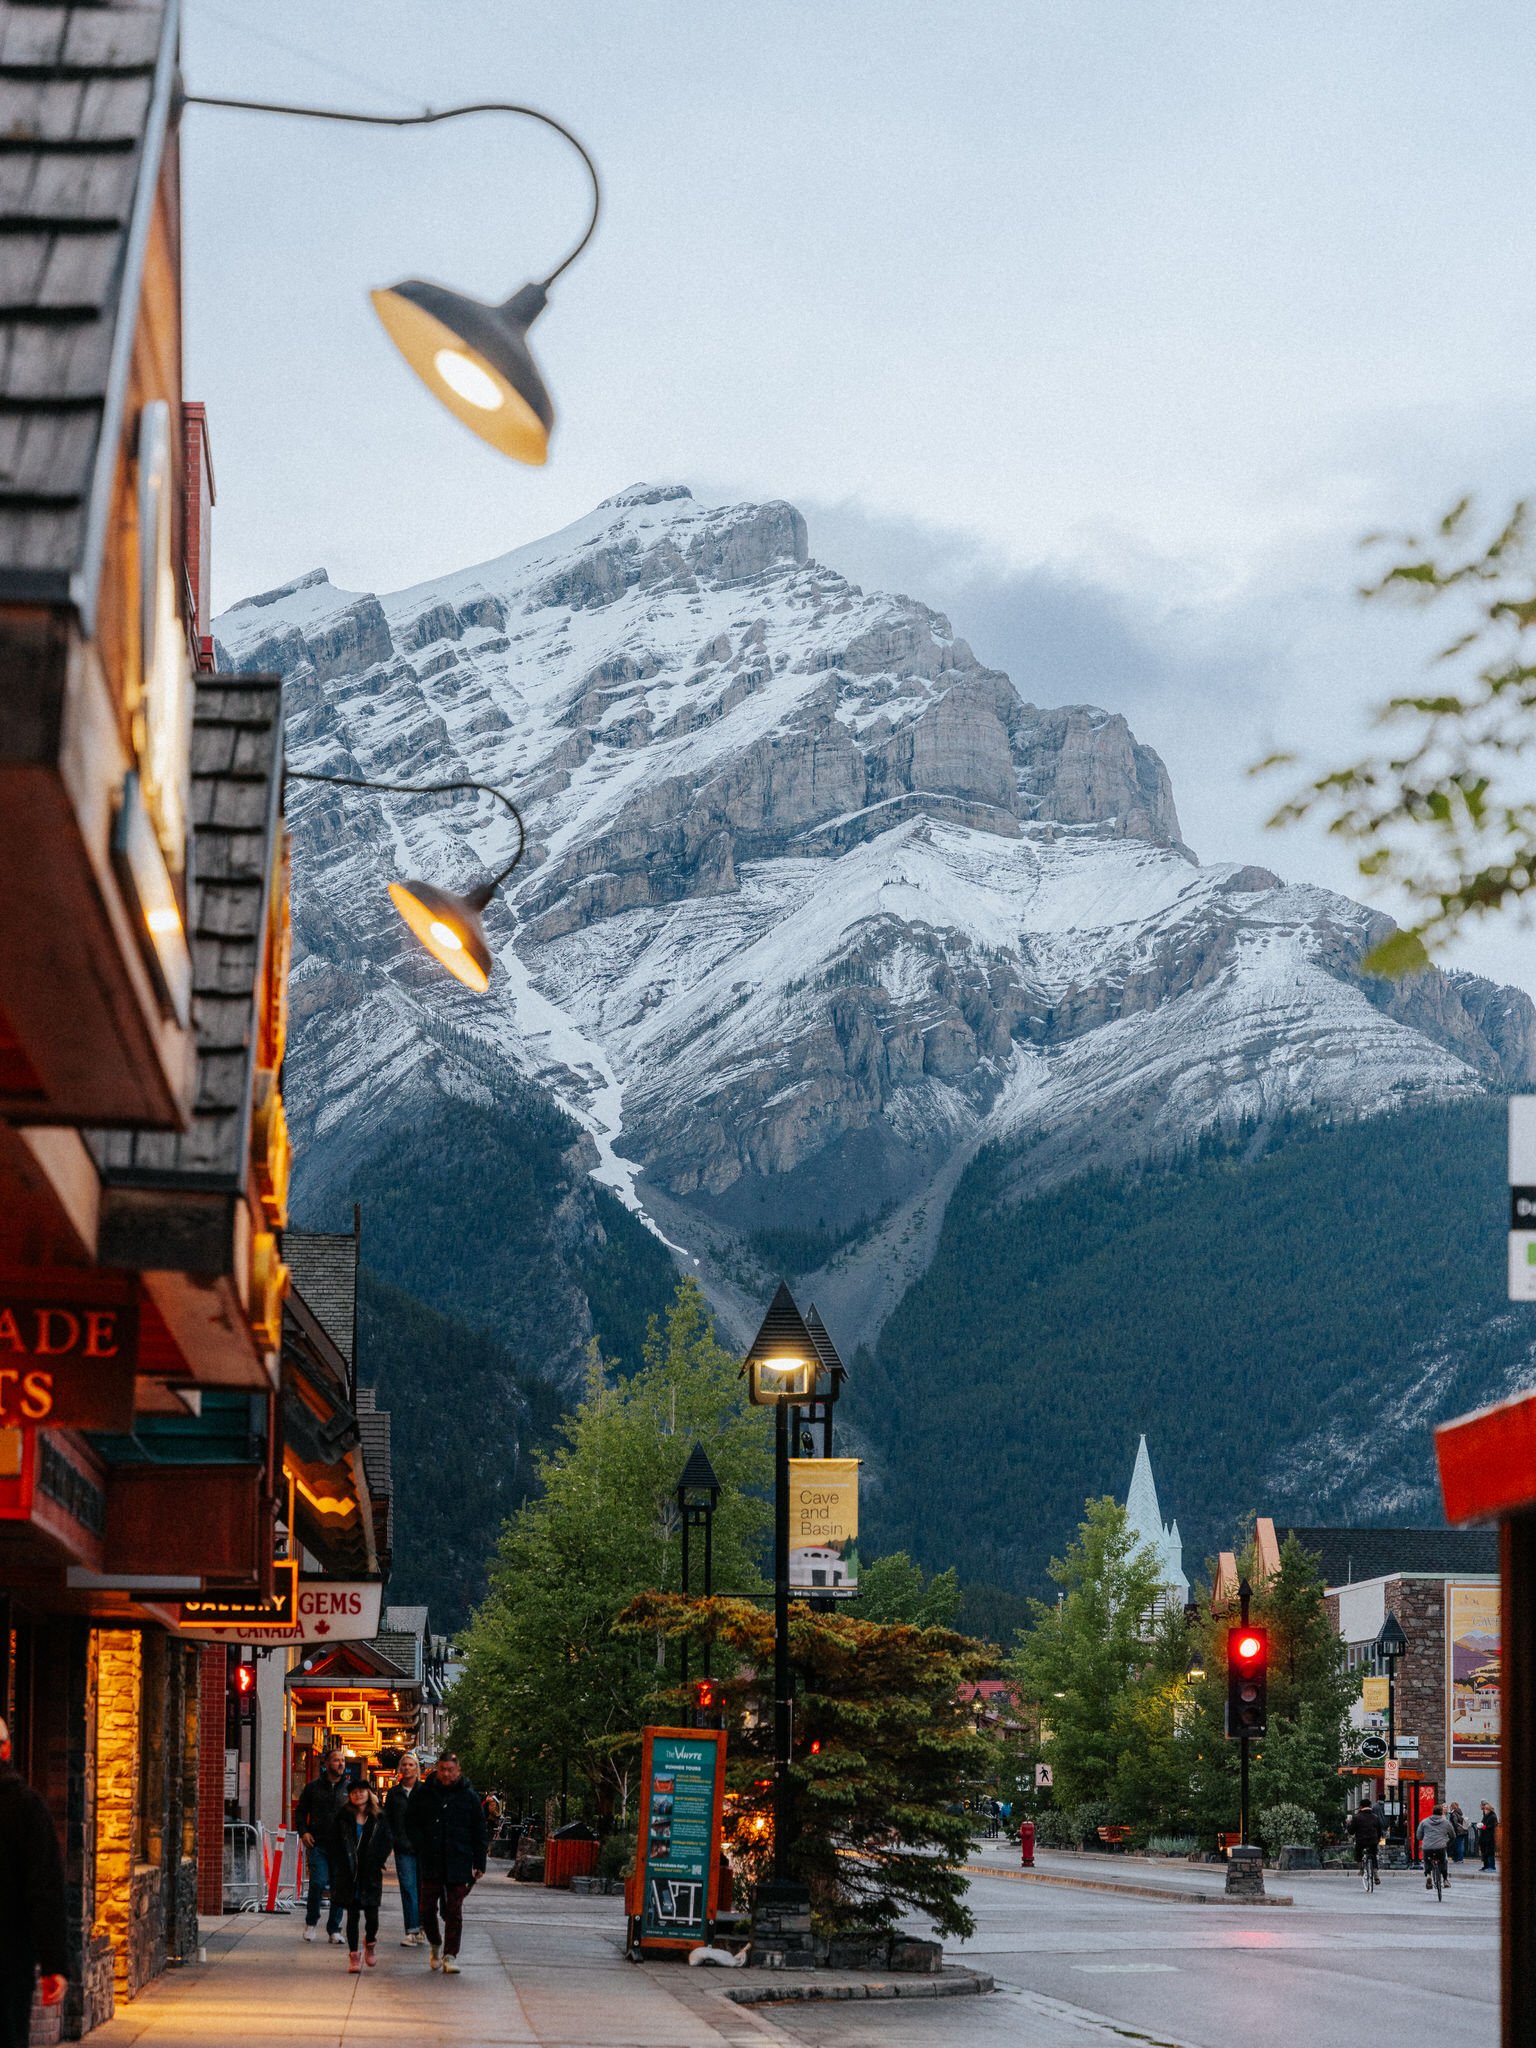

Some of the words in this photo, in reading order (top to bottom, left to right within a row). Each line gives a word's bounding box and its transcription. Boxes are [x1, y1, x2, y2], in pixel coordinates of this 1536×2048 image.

[800, 1490, 839, 1504] Cave
[800, 1506, 829, 1519] and
[801, 1521, 843, 1536] Basin
[300, 1592, 361, 1615] GEMS
